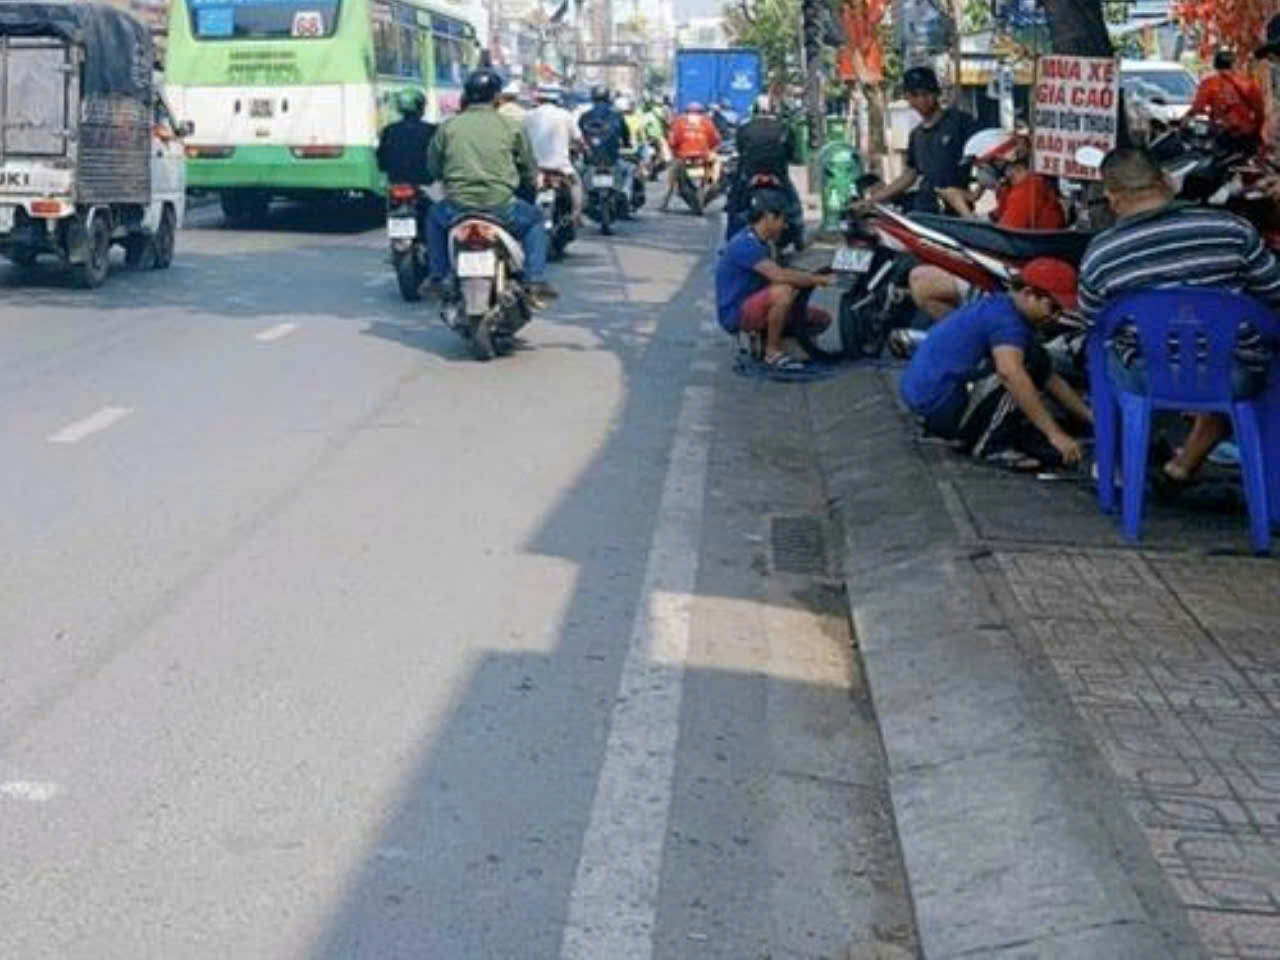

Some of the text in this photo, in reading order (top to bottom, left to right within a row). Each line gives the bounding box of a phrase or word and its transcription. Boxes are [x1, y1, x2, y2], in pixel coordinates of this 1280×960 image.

[1041, 60, 1114, 82] MUA XE
[1070, 85, 1115, 109] CAO
